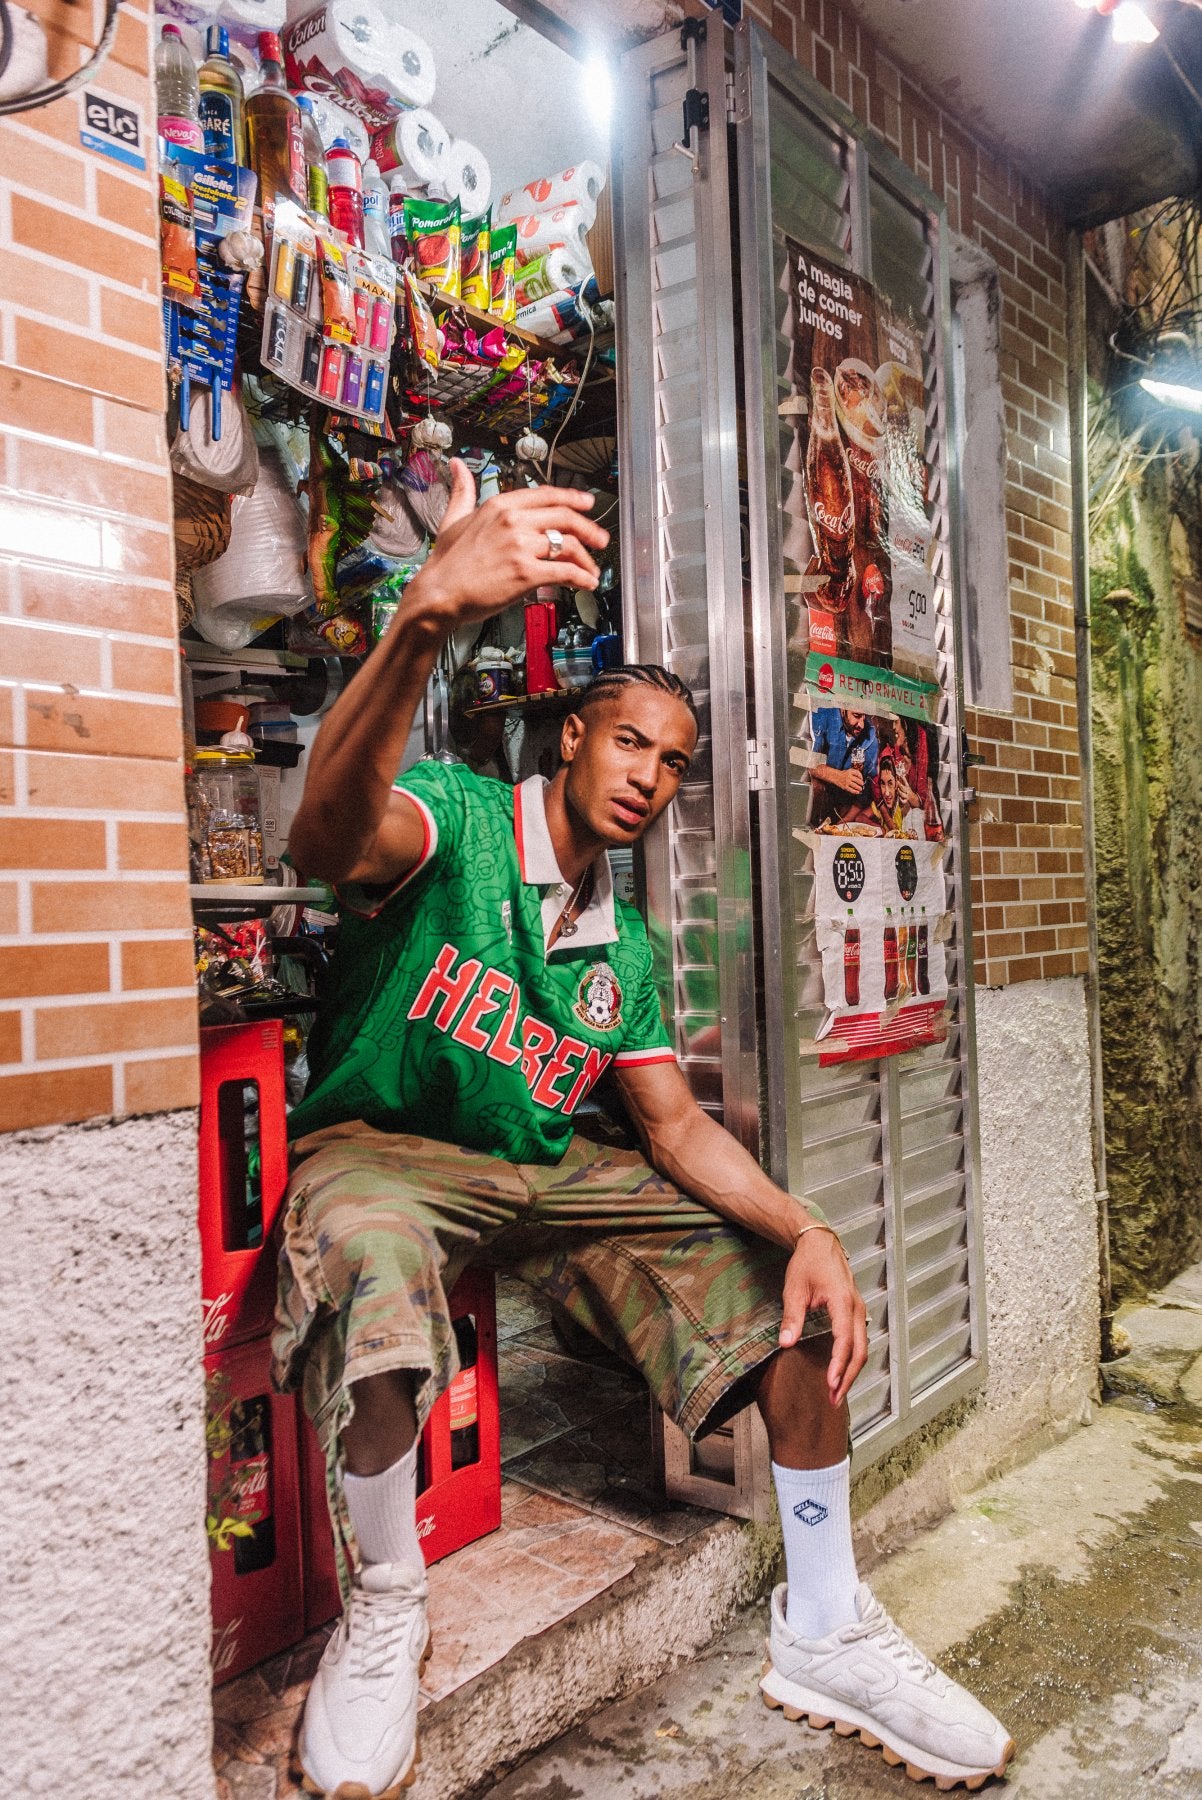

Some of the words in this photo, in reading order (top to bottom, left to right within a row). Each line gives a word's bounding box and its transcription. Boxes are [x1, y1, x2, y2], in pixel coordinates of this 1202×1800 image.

[288, 14, 326, 53] Cotton
[87, 104, 138, 140] elo
[193, 172, 233, 193] Gillette
[234, 196, 249, 211] 2
[362, 281, 391, 299] MAXI
[797, 255, 808, 276] A
[811, 264, 853, 302] magia
[798, 278, 816, 304] de
[818, 293, 863, 327] comer
[799, 299, 843, 340] juntos
[809, 622, 834, 641] Coca-Cola
